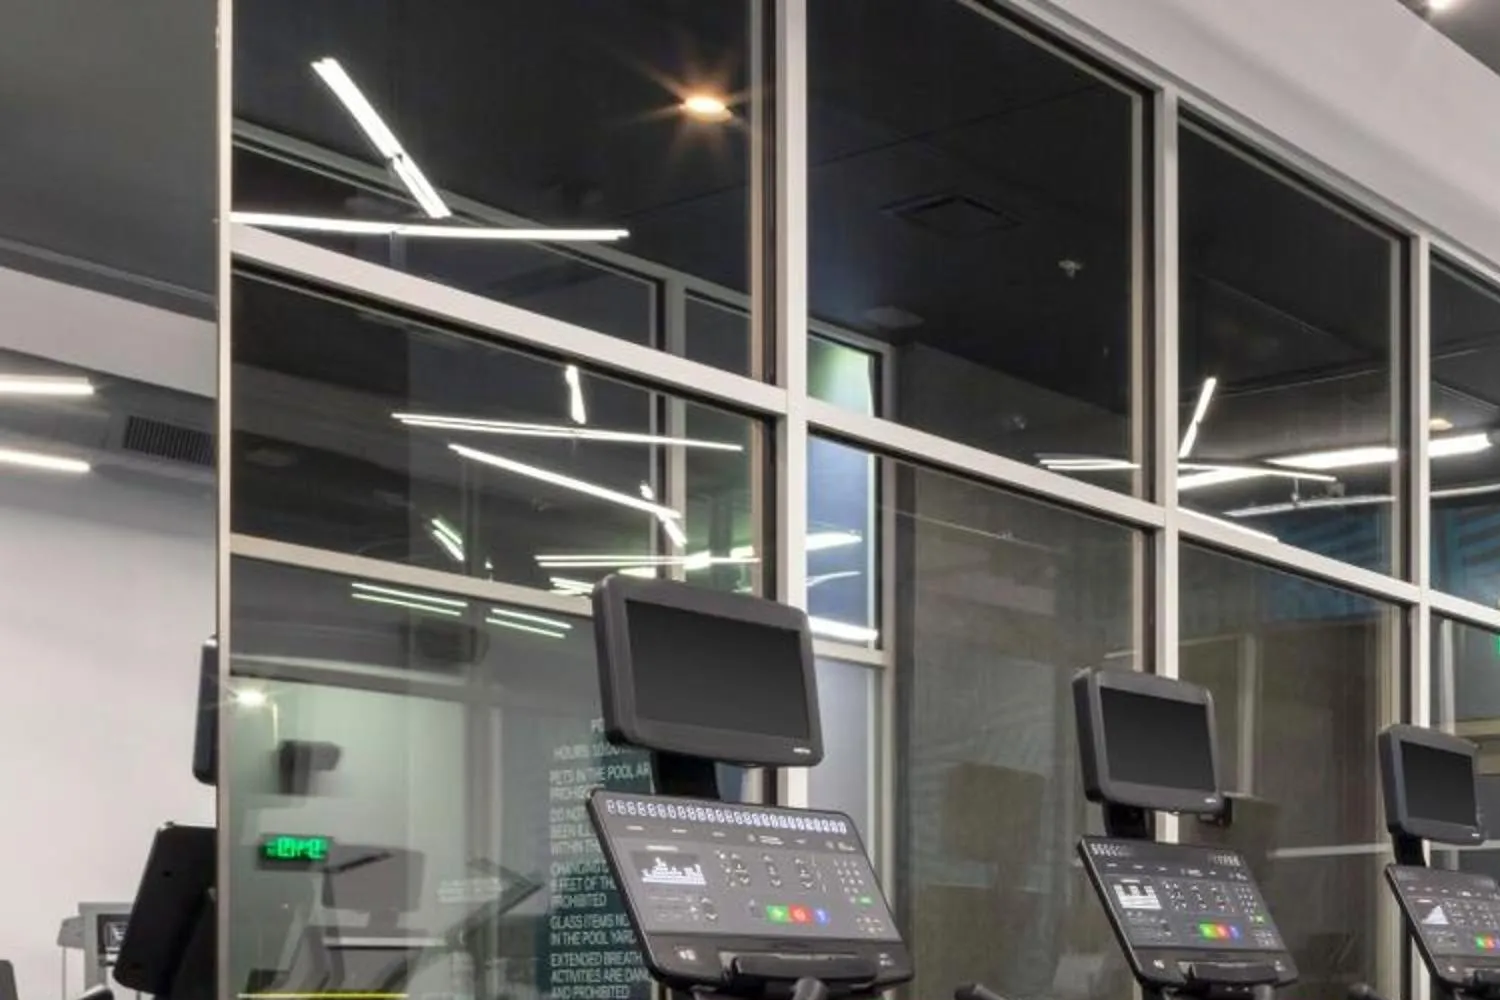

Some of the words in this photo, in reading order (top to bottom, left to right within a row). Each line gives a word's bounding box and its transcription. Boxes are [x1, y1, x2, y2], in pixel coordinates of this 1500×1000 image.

[607, 764, 634, 780] POOL
[561, 877, 583, 892] FEET
[584, 876, 597, 891] OF
[551, 891, 607, 910] PROHIBITED
[550, 913, 582, 929] GLASS
[583, 913, 614, 928] ITEMS
[551, 930, 561, 946] IN
[562, 930, 581, 945] THE
[582, 930, 609, 945] POOL
[551, 951, 602, 967] EXTENDED
[603, 950, 643, 966] BREATH
[551, 967, 601, 983] ACTIVITIES
[603, 967, 623, 982] ARE
[551, 985, 571, 1000] AND
[572, 984, 630, 1000] PROHIBITED
